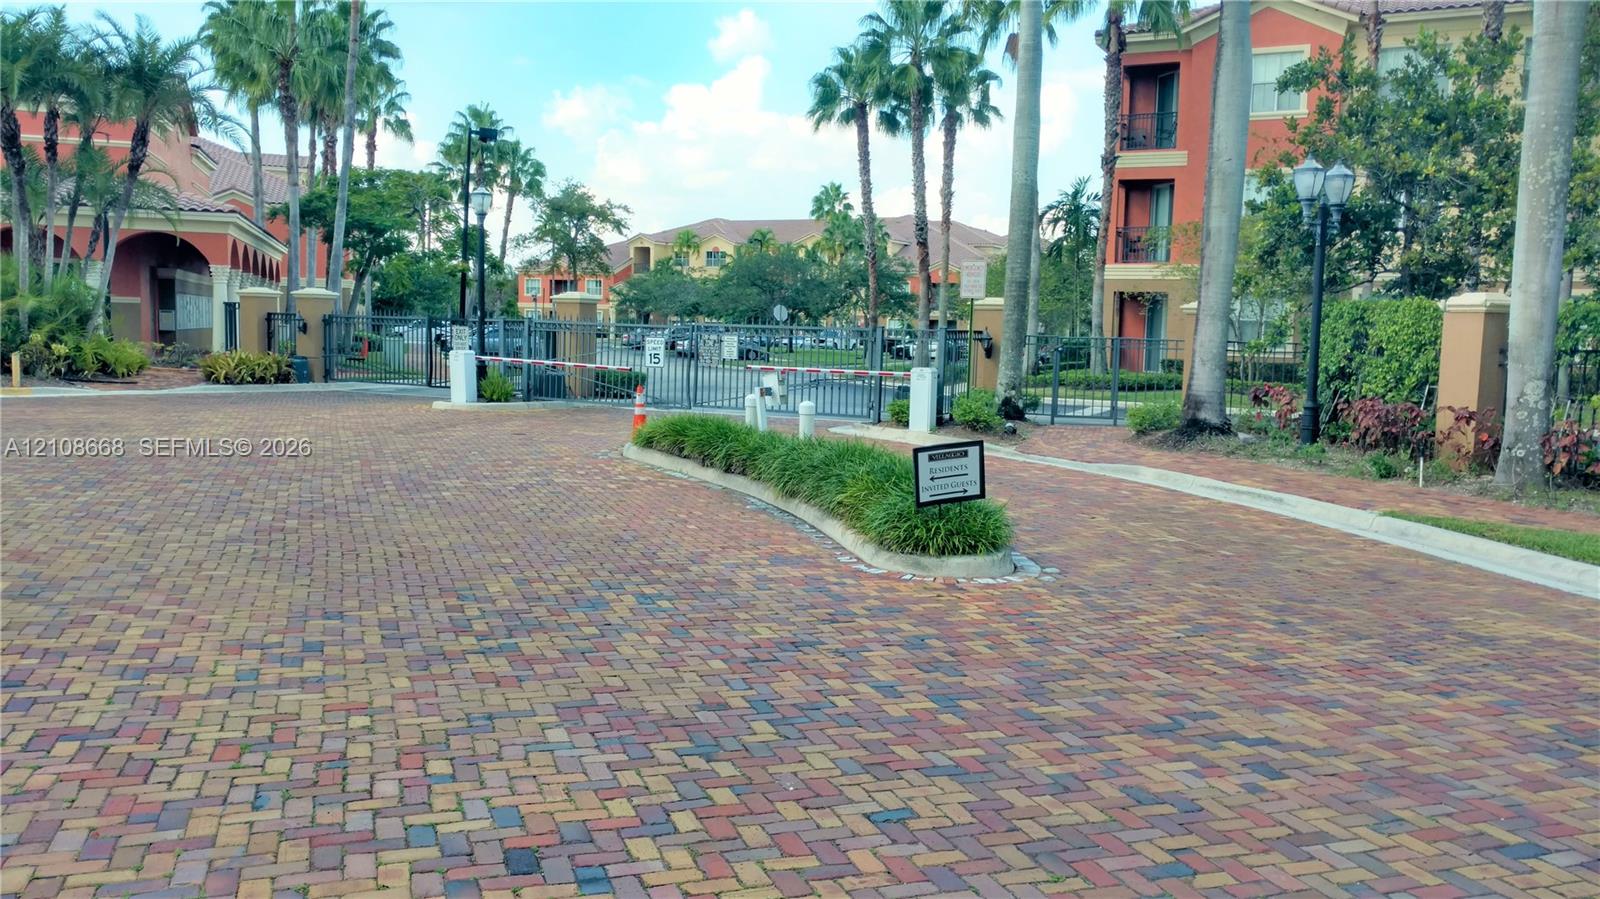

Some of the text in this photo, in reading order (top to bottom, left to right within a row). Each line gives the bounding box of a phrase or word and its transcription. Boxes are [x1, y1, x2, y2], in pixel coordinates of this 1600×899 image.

[648, 353, 661, 365] 15
[931, 451, 965, 460] VILLAGGIO
[929, 464, 968, 475] RESIDENTS
[921, 480, 977, 493] INVITED GUESTS
